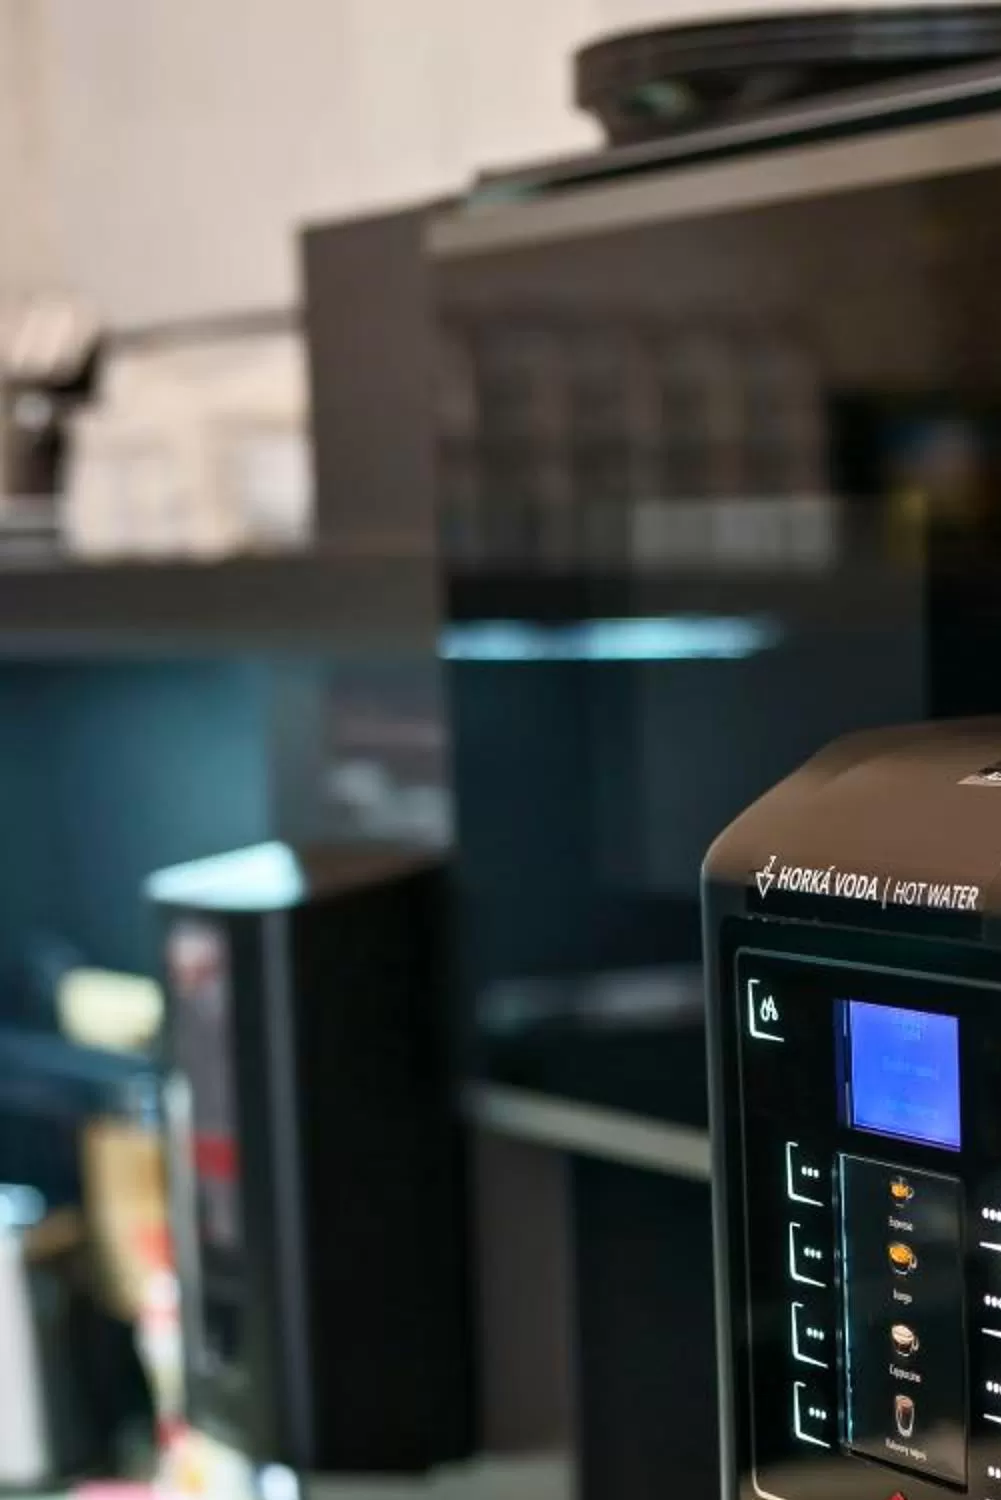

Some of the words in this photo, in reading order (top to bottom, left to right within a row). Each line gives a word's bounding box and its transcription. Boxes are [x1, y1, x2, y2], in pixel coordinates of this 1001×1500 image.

[777, 865, 835, 895] HORKÁ
[834, 871, 878, 900] VODA
[893, 880, 928, 906] HOT
[927, 883, 980, 911] WATER
